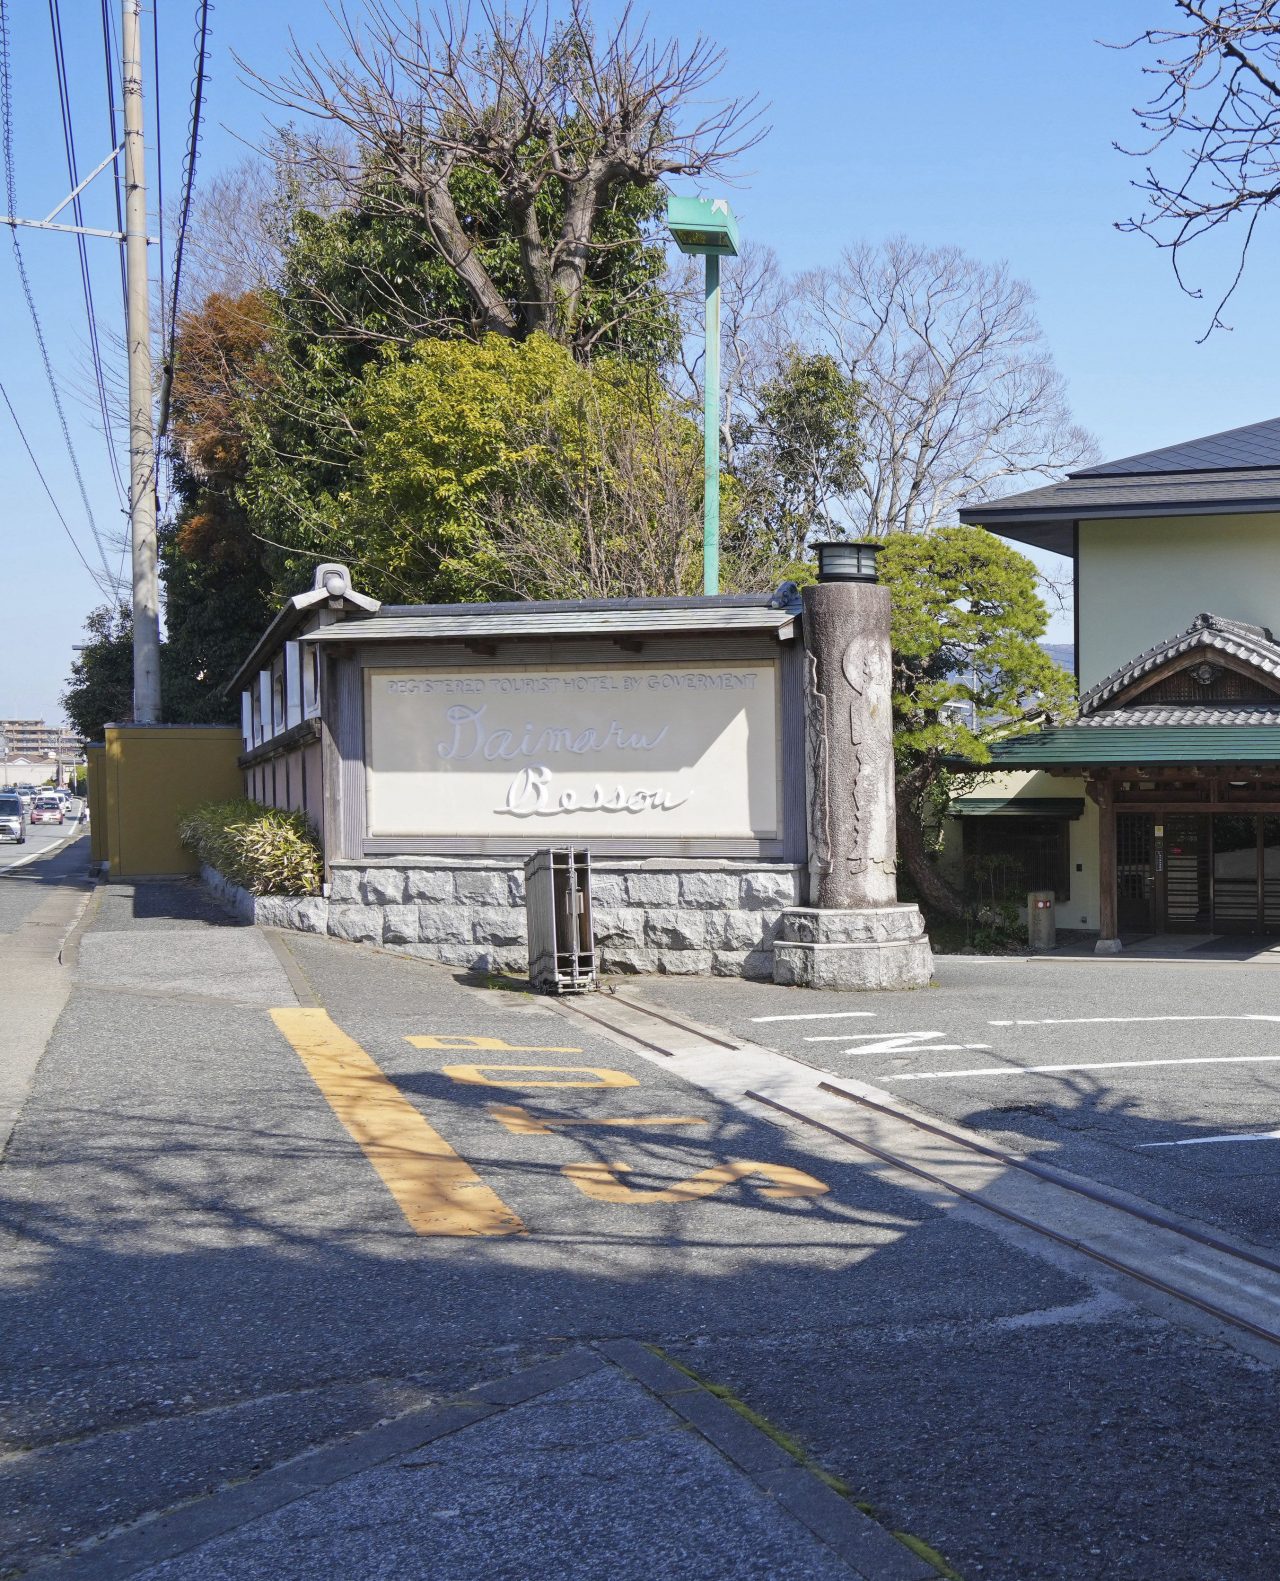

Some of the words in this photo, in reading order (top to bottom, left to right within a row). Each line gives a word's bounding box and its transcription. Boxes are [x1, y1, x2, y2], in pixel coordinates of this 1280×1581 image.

[387, 679, 485, 695] REGISTERED
[488, 677, 560, 694] TOURIST
[563, 676, 618, 693] HOTEL
[623, 675, 643, 691] BY
[647, 673, 757, 690] GOVERMENT
[438, 704, 669, 761] Daimaru
[493, 764, 693, 818] Bessou
[405, 1034, 829, 1202] STOP
